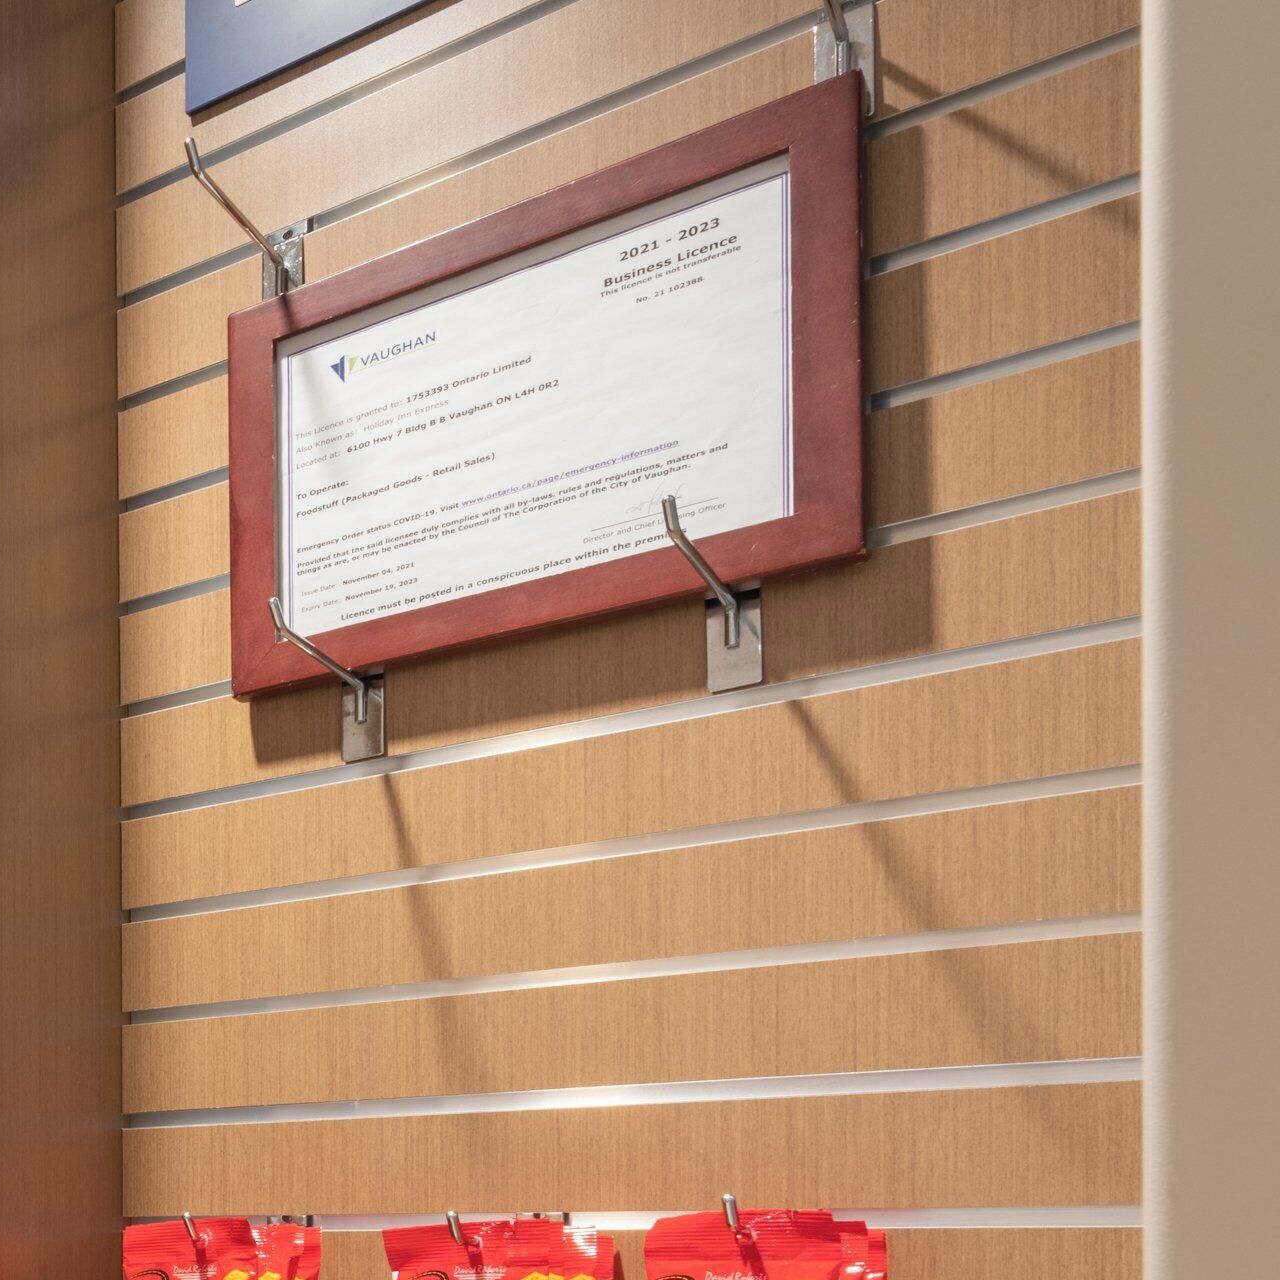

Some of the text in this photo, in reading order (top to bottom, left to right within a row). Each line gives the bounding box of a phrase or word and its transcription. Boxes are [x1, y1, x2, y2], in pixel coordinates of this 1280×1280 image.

[603, 235, 738, 288] Business Licence
[619, 239, 659, 262] 2021
[678, 217, 720, 241] 2023
[600, 287, 619, 298] This
[620, 276, 653, 291] licence
[665, 265, 681, 276] not
[682, 245, 742, 270] transferable
[360, 331, 436, 367] VAUGHAN
[295, 430, 312, 441] This
[314, 419, 344, 435] Licence
[355, 404, 388, 423] granted
[406, 383, 449, 404] 1753393
[451, 371, 490, 388] Ontario
[492, 355, 532, 375] Limited
[296, 454, 328, 471] Located
[346, 440, 371, 454] 6100
[372, 433, 394, 445] Hwy
[404, 423, 427, 435] Bldg
[448, 401, 493, 420] Vaughan
[514, 386, 535, 400] L4H
[538, 379, 559, 392] 0R2
[296, 499, 339, 519] Foodstuff
[341, 484, 390, 506] (Packaged
[392, 475, 423, 489] Goods
[432, 462, 462, 477] Retail
[463, 451, 496, 468] Sales)
